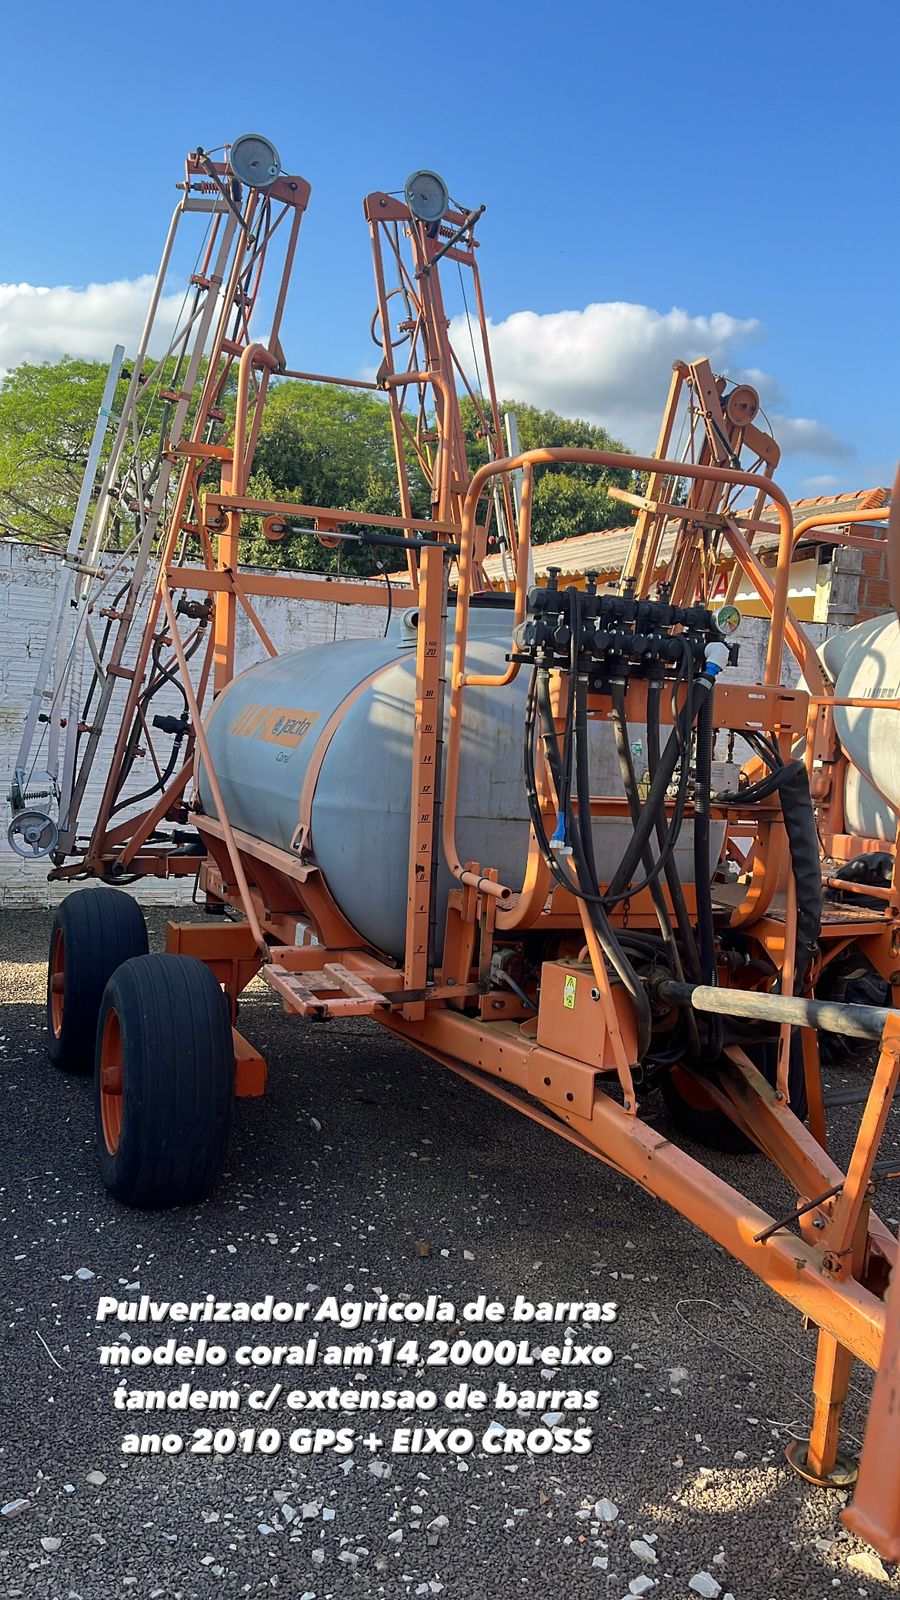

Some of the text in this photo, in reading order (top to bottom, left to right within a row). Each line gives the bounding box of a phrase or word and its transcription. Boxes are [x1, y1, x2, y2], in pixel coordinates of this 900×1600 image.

[427, 648, 437, 656] 20
[277, 718, 311, 736] jacto
[275, 752, 292, 763] Coral
